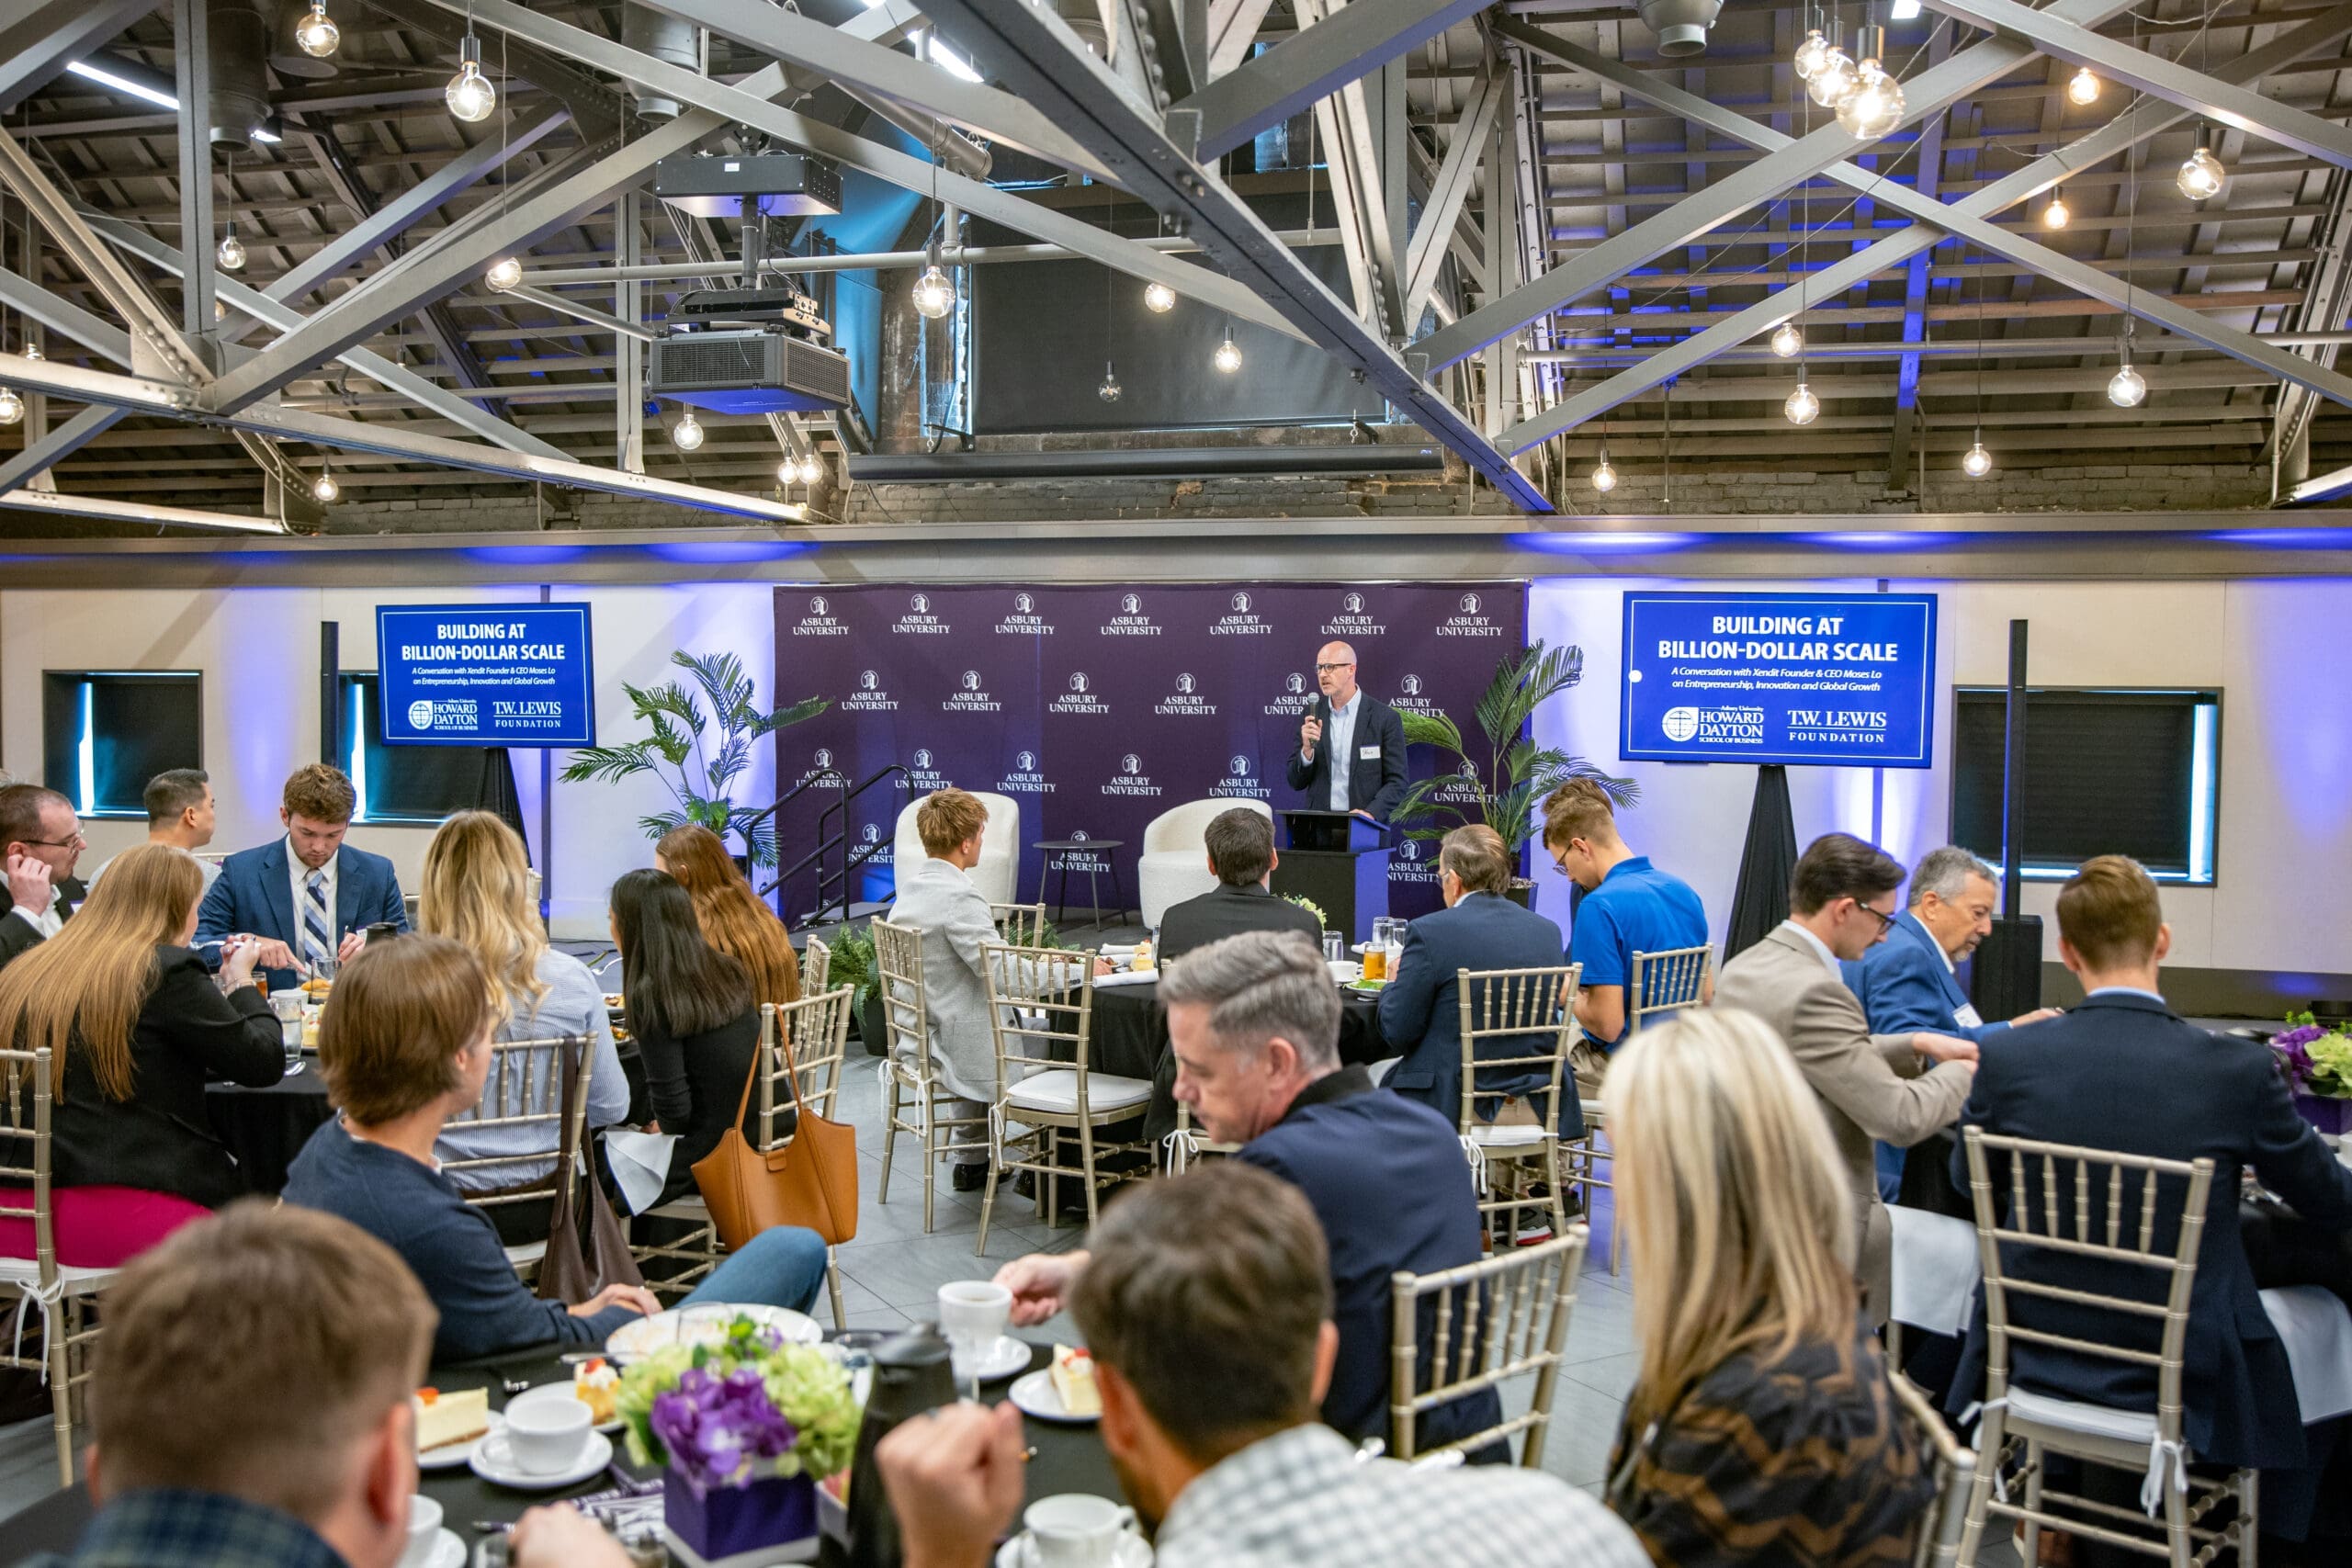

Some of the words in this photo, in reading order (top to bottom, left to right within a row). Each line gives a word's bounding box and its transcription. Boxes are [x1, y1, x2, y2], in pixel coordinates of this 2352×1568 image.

[800, 617, 837, 626] ASBURY
[900, 615, 939, 625] ASBURY
[1003, 615, 1043, 625] ASBURY
[1110, 616, 1150, 626] ASBURY
[1219, 615, 1261, 625] ASBURY
[1330, 615, 1374, 626] ASBURY
[1446, 616, 1490, 626] ASBURY
[792, 626, 849, 636] UNIVERSITY
[892, 624, 950, 634] UNIVERSITY
[995, 625, 1055, 635] UNIVERSITY
[1101, 626, 1162, 636] UNIVERSITY
[1209, 625, 1272, 635] UNIVERSITY
[1321, 625, 1386, 635] UNIVERSITY
[1713, 616, 1812, 635] BUILDING
[1816, 617, 1844, 636] AT
[437, 624, 505, 639] BUILDING
[508, 624, 526, 638] AT
[1436, 626, 1503, 637] UNIVERSITY
[401, 645, 518, 660] BILLION-DOLLAR
[520, 644, 566, 660] SCALE
[1658, 640, 1828, 660] BILLION-DOLLAR
[1833, 643, 1898, 661] SCALE
[412, 667, 417, 675] A
[417, 667, 454, 675] Conversation
[1671, 667, 1679, 675] A
[1679, 667, 1732, 676] Conversation
[1733, 668, 1751, 676] with
[1752, 668, 1780, 677] Xendit
[1780, 669, 1815, 677] Founder
[1815, 669, 1823, 677] &
[1824, 670, 1842, 678] CEO
[1843, 670, 1870, 678] Moses
[1871, 671, 1883, 679] Lo
[422, 678, 469, 686] Entrepreneurship,
[1684, 680, 1754, 690] Entrepreneurship,
[1756, 681, 1801, 690] Innovation
[1801, 682, 1819, 690] and
[1819, 682, 1848, 691] Global
[1849, 682, 1881, 691] Growth
[850, 692, 888, 701] ASBURY
[951, 692, 989, 702] ASBURY
[1057, 694, 1098, 704] ASBURY
[1164, 695, 1204, 705] ASBURY
[1274, 695, 1308, 705] ASBUR
[842, 701, 899, 710] UNIVERSITY
[943, 702, 1001, 712] UNIVERSITY
[1388, 697, 1431, 707] ASBURY
[434, 704, 478, 713] HOWARD
[492, 701, 517, 715] T.W.
[519, 701, 562, 715] LEWIS
[1048, 704, 1110, 714] UNIVERSITY
[1155, 705, 1217, 715] UNIVERSITY
[1264, 705, 1304, 716] UNIVER
[434, 714, 478, 725] DAYTON
[1700, 712, 1764, 724] HOWARD
[1787, 710, 1822, 726] T.W.
[1826, 711, 1887, 728] LEWIS
[495, 719, 561, 728] FOUNDATION
[1699, 724, 1764, 737] DAYTON
[1789, 732, 1884, 743] FOUNDATION
[1005, 773, 1044, 783] ASBURY
[1111, 776, 1150, 785] ASBURY
[1218, 778, 1259, 787] ASBURY
[895, 780, 953, 789] UNVERSITY
[996, 782, 1057, 793] UNIVERSITY
[1102, 785, 1162, 795] UNIVERSITY
[1209, 787, 1272, 797] UNIVERSITY
[1434, 793, 1500, 804] UNIVERSIT
[1387, 873, 1441, 883] NIVERSIT
